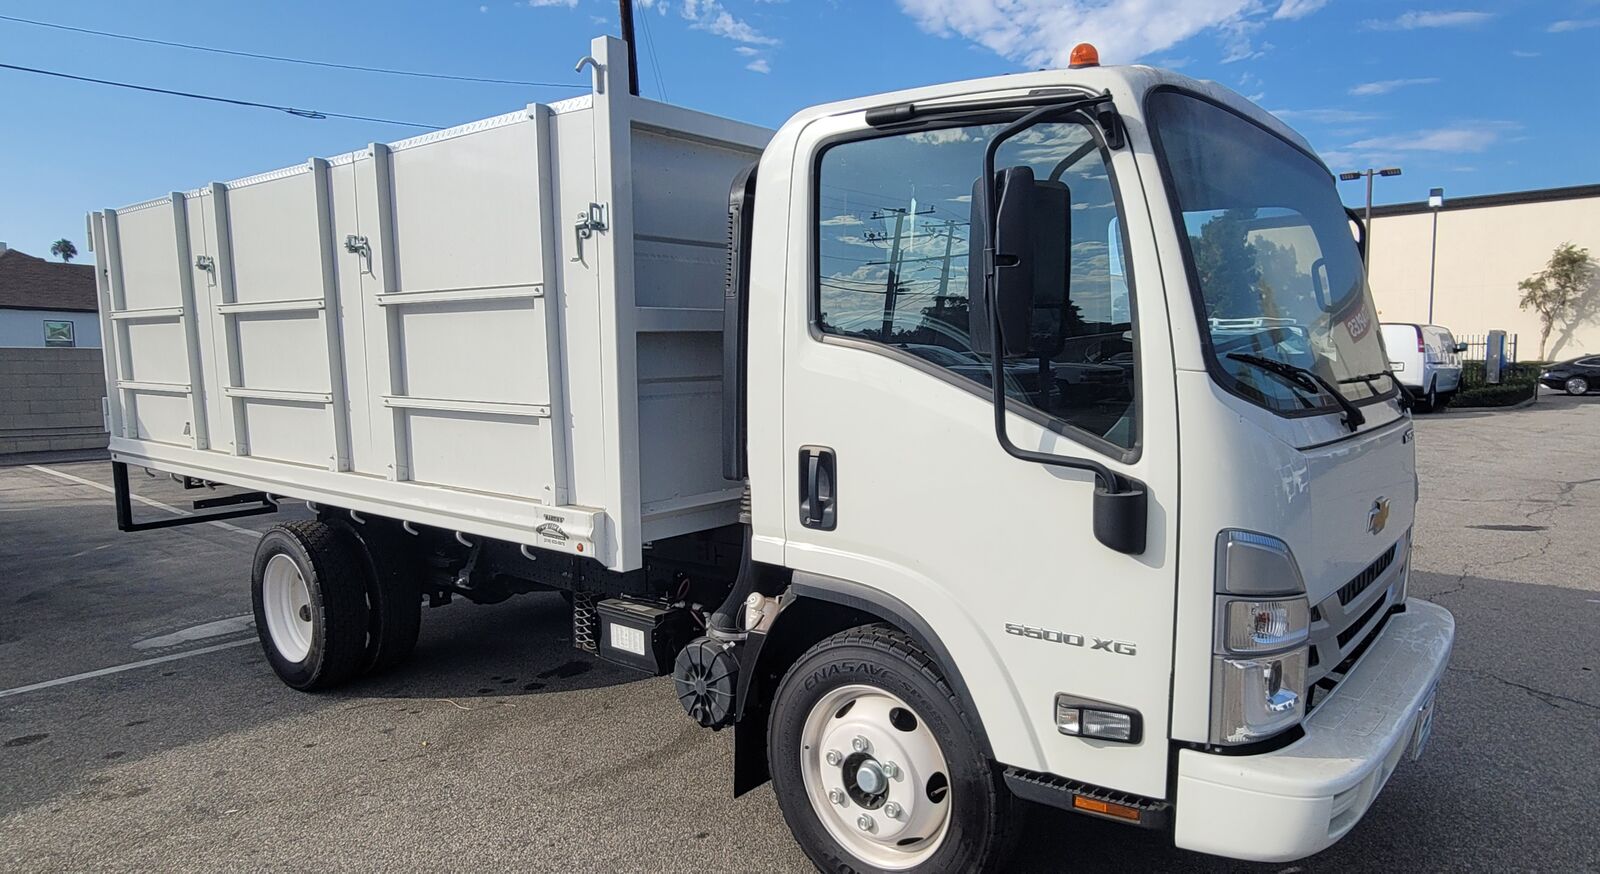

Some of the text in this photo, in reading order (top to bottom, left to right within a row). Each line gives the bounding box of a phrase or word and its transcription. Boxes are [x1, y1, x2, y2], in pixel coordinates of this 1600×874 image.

[1004, 622, 1137, 656] 5500 XG
[804, 661, 898, 692] ENASAVE
